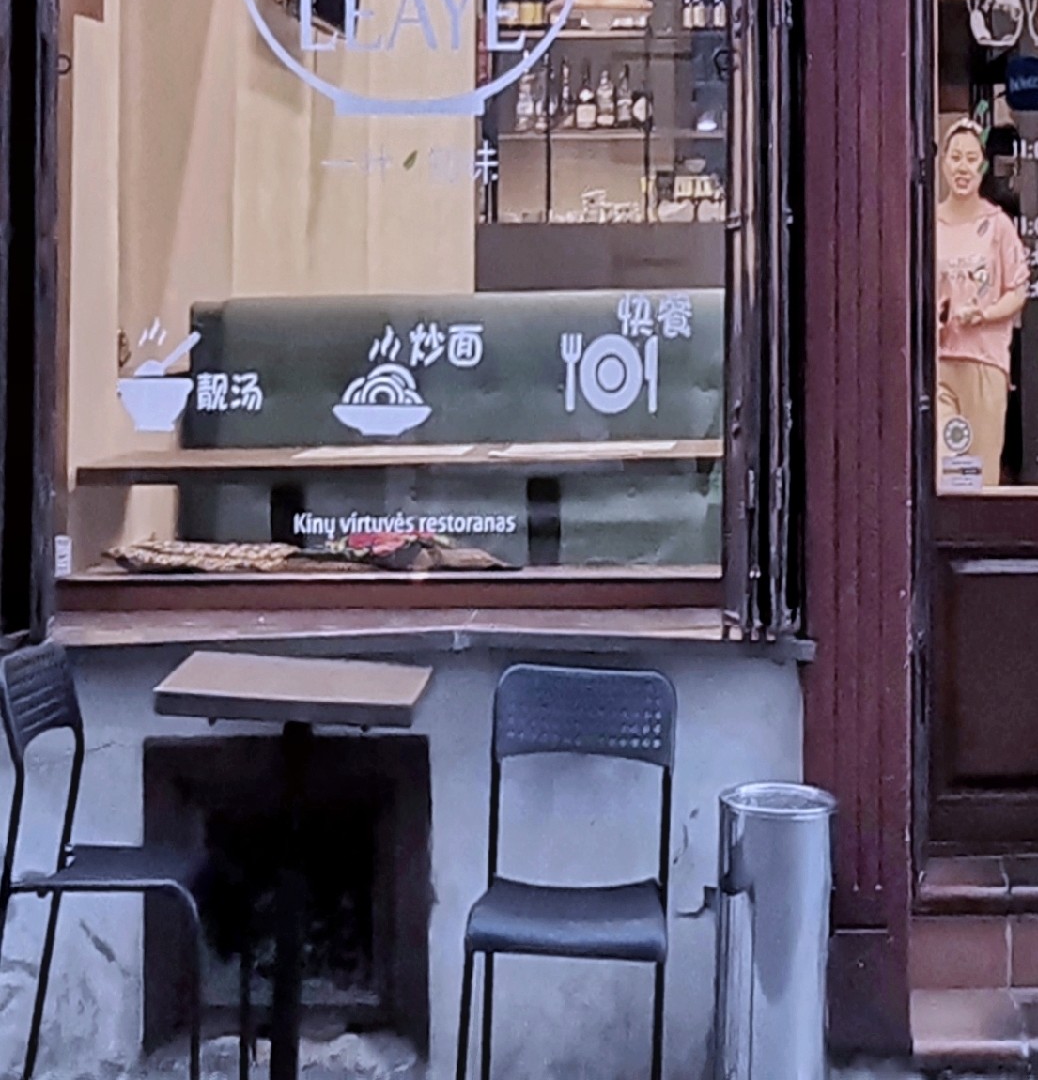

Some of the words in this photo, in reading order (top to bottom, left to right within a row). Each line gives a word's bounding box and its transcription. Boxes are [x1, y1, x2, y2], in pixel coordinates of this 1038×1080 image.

[618, 293, 693, 339] 快餐
[409, 322, 485, 367] 炒面
[196, 372, 263, 411] 靓汤
[293, 512, 335, 539] Kinų
[339, 511, 414, 533] virtuvės
[418, 514, 517, 533] restoranas
